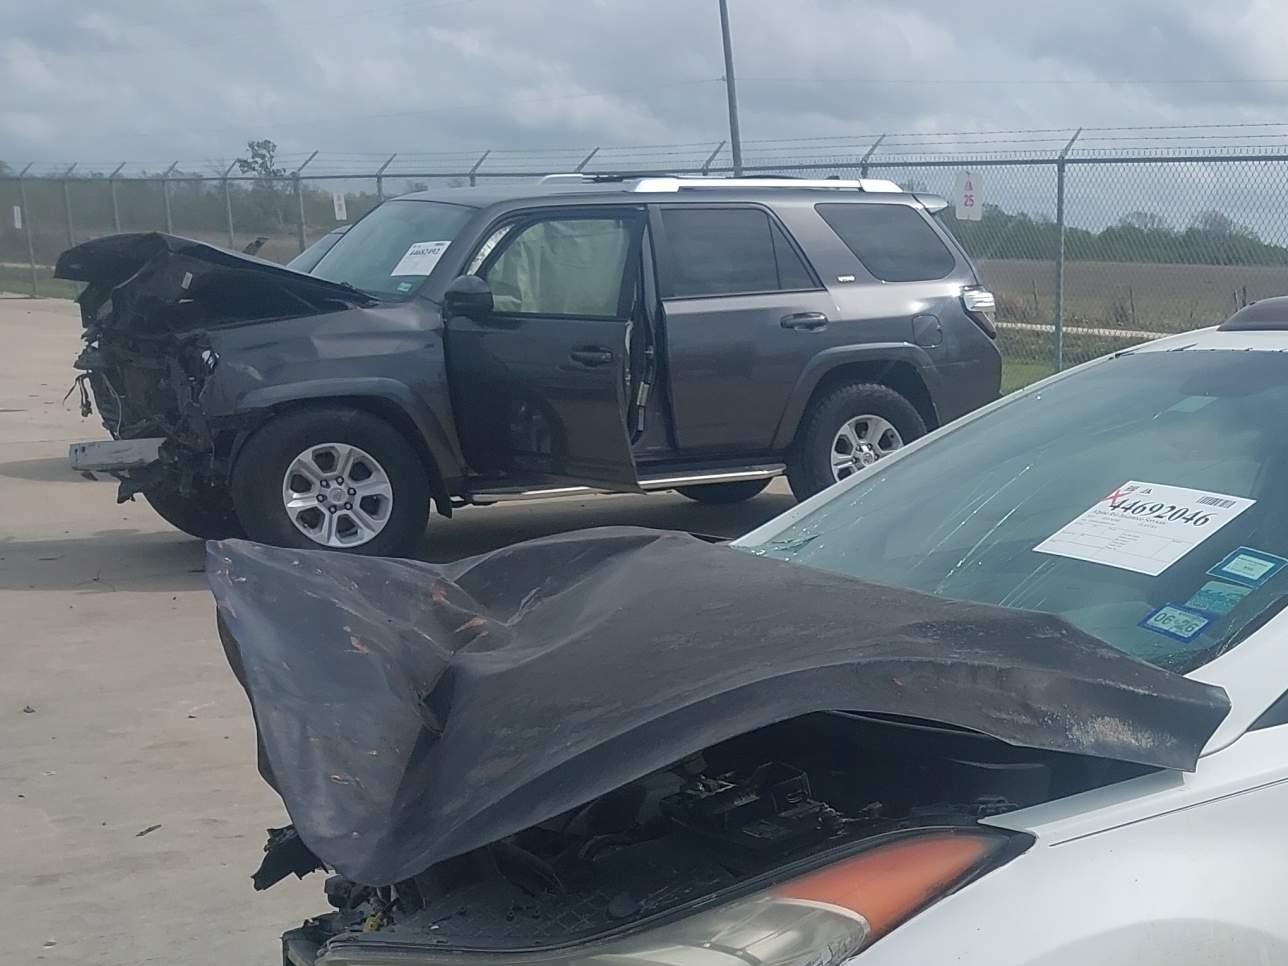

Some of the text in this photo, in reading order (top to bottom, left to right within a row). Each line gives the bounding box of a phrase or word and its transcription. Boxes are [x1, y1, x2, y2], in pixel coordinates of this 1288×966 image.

[964, 194, 975, 207] 25
[1109, 498, 1217, 526] 44692046
[1154, 612, 1173, 626] 06
